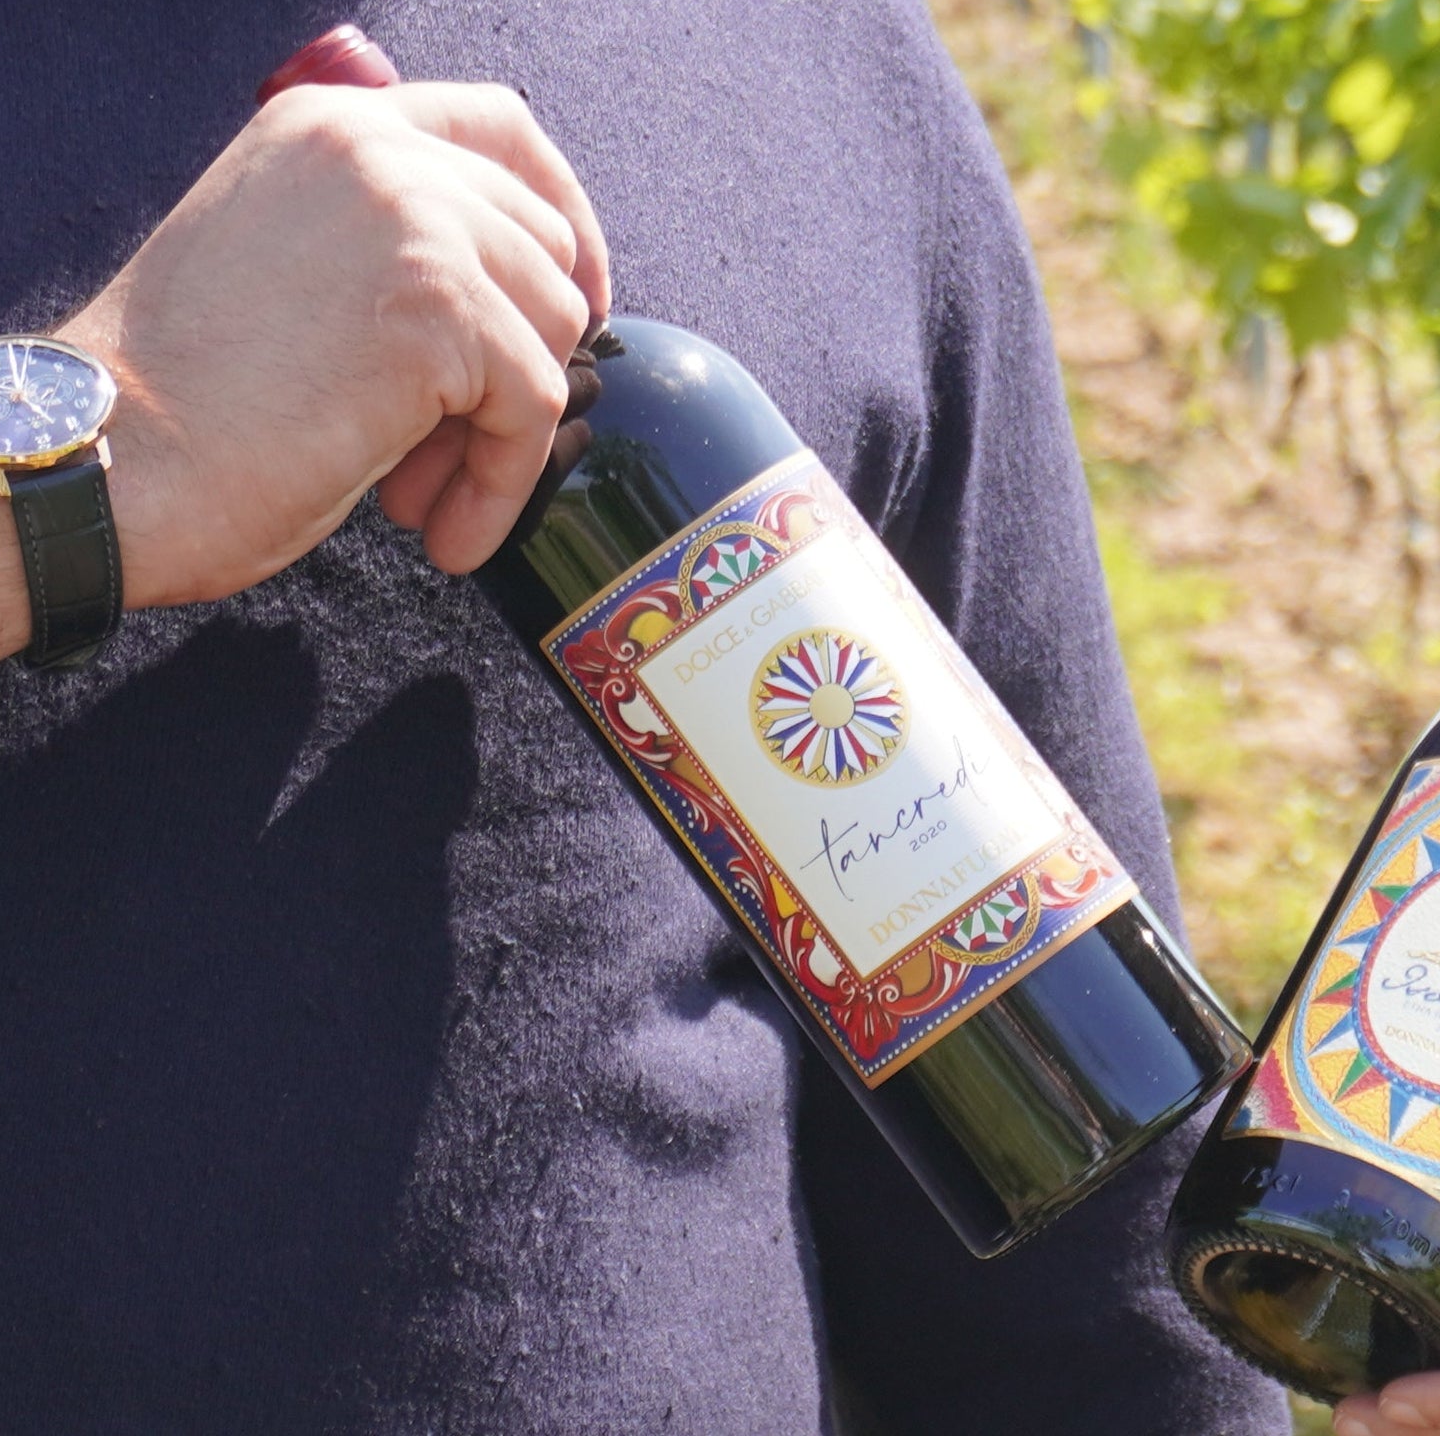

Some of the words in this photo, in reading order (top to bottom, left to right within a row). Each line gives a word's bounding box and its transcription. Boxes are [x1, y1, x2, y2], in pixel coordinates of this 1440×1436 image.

[673, 625, 744, 684] DOLCE
[744, 626, 754, 637] &
[750, 566, 830, 626] GABBA
[799, 734, 990, 902] tancredi
[909, 819, 948, 853] 2020
[867, 826, 1024, 946] DONNAFUGA
